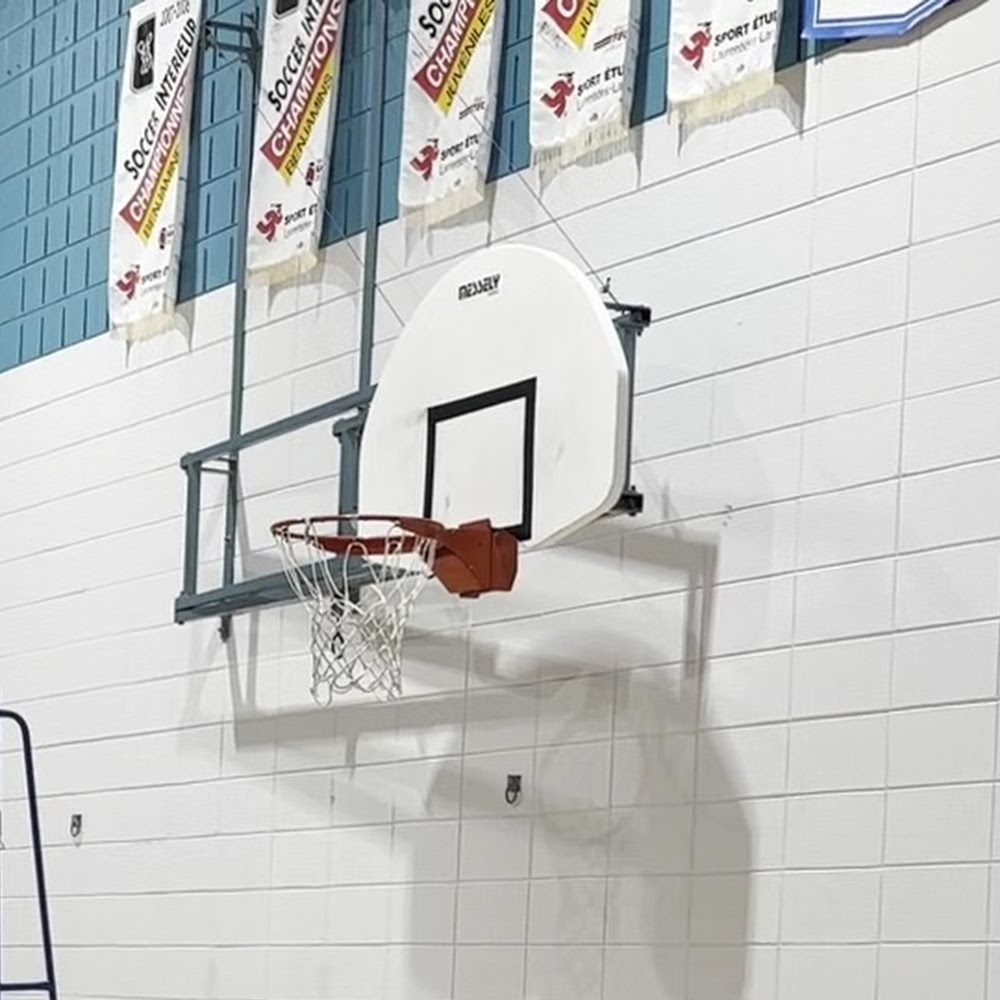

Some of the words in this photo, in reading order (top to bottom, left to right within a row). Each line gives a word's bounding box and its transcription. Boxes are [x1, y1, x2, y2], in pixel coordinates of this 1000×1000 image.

[267, 36, 306, 113] SOCCER
[444, 0, 496, 106] JUVENILES
[713, 22, 750, 47] SPORT
[129, 76, 188, 223] CHAMPIONNE
[285, 73, 333, 176] BENJAMINS
